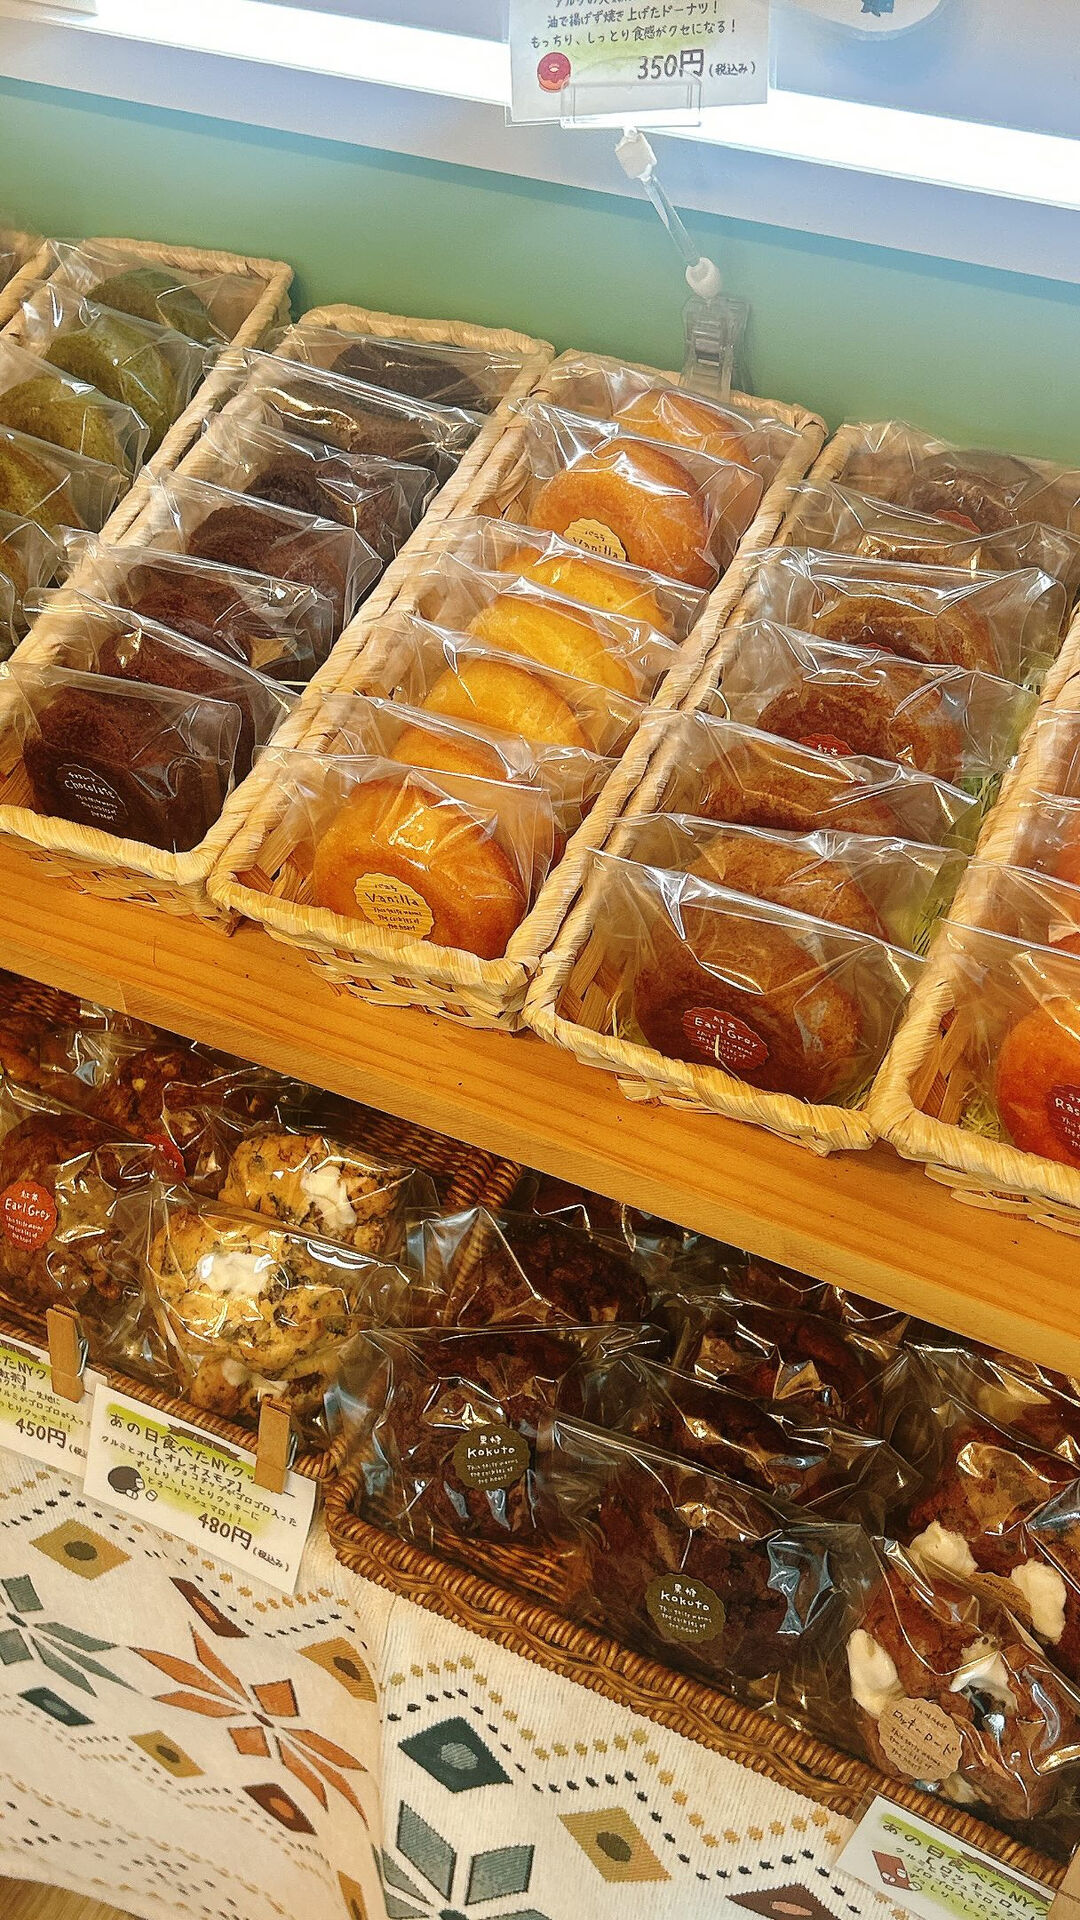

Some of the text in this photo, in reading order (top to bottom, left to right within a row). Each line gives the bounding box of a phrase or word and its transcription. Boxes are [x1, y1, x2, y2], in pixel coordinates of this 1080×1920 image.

[637, 48, 704, 79] 350円
[364, 891, 420, 907] Vanilla
[16, 1417, 67, 1449] 450円
[467, 1445, 516, 1459] Kokuto
[197, 1512, 253, 1551] 480円
[660, 1589, 710, 1611] Kokuto
